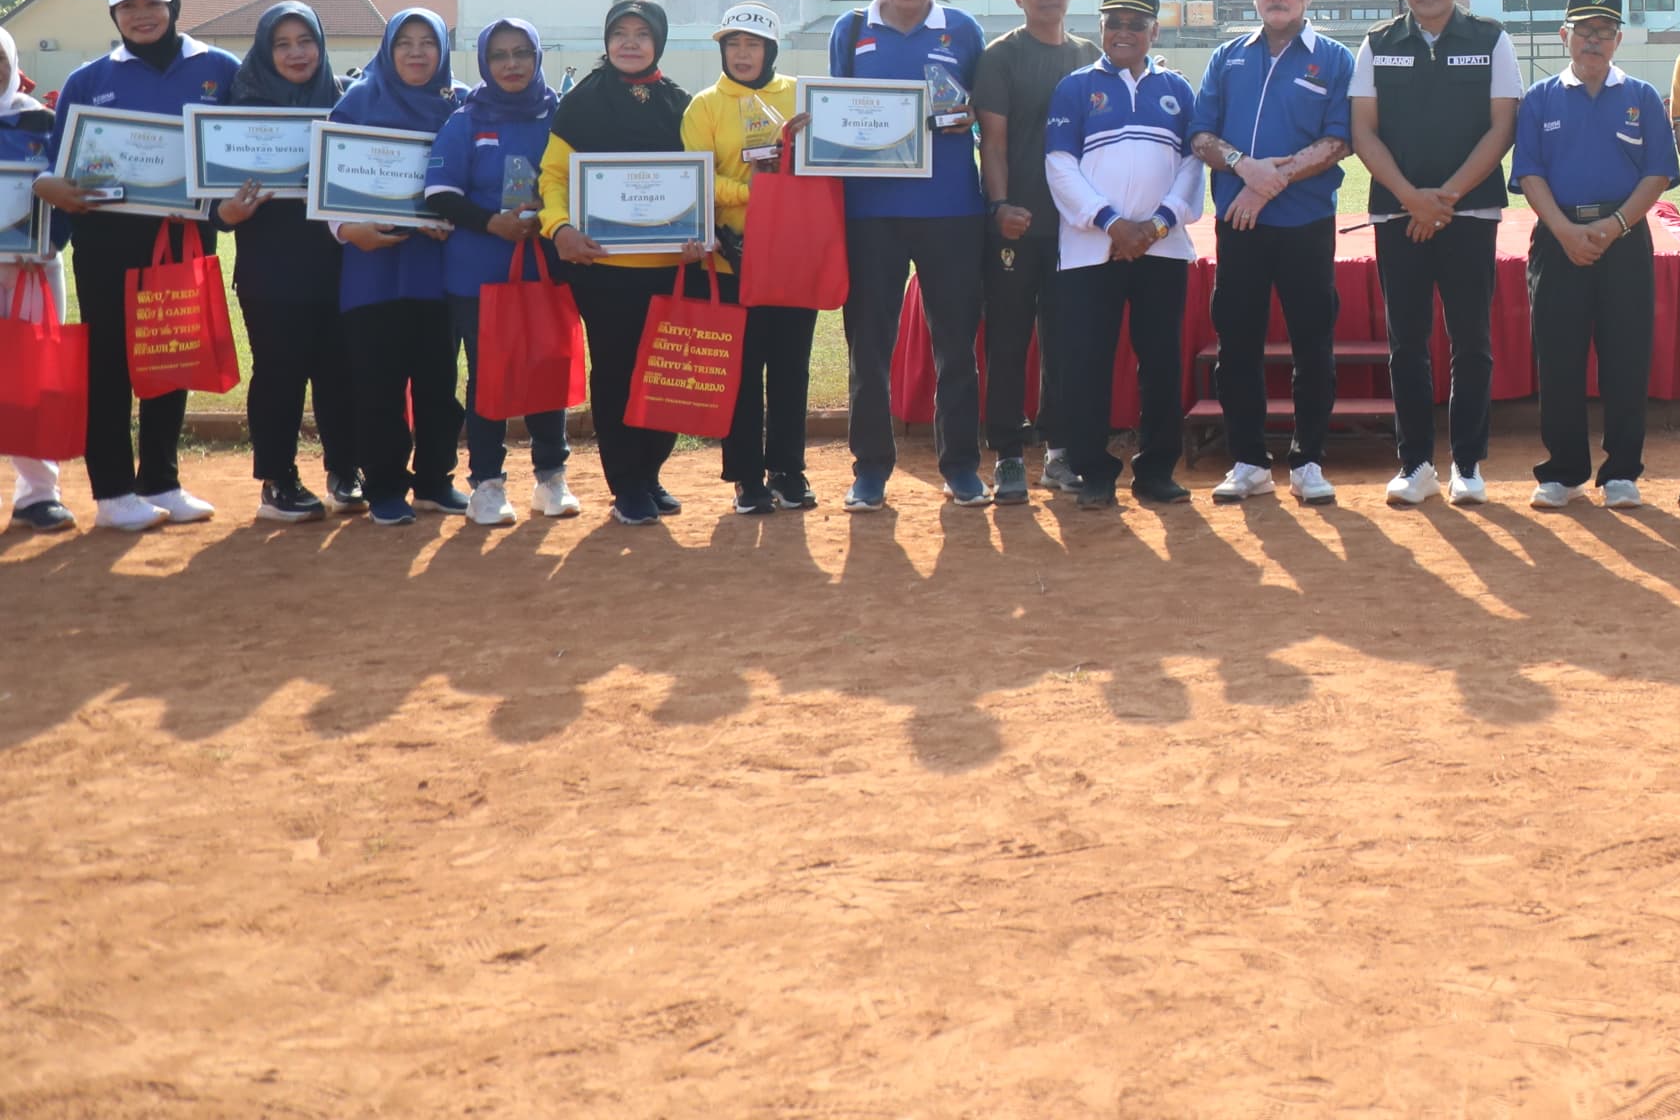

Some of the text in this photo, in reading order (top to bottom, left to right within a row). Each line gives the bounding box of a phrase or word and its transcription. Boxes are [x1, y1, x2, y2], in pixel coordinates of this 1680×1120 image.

[1375, 56, 1413, 66] SUBANDI
[1454, 56, 1484, 65] BUPATI
[841, 118, 889, 129] Jemirahan
[225, 144, 272, 153] Jimbaran
[337, 164, 424, 180] Tambak kemeraka
[620, 192, 665, 203] Larangan
[696, 329, 733, 342] REDJO
[690, 345, 730, 358] GANESYA
[694, 364, 727, 376] TRISNA
[660, 376, 686, 388] GALUH
[695, 381, 726, 393] HARDJO
